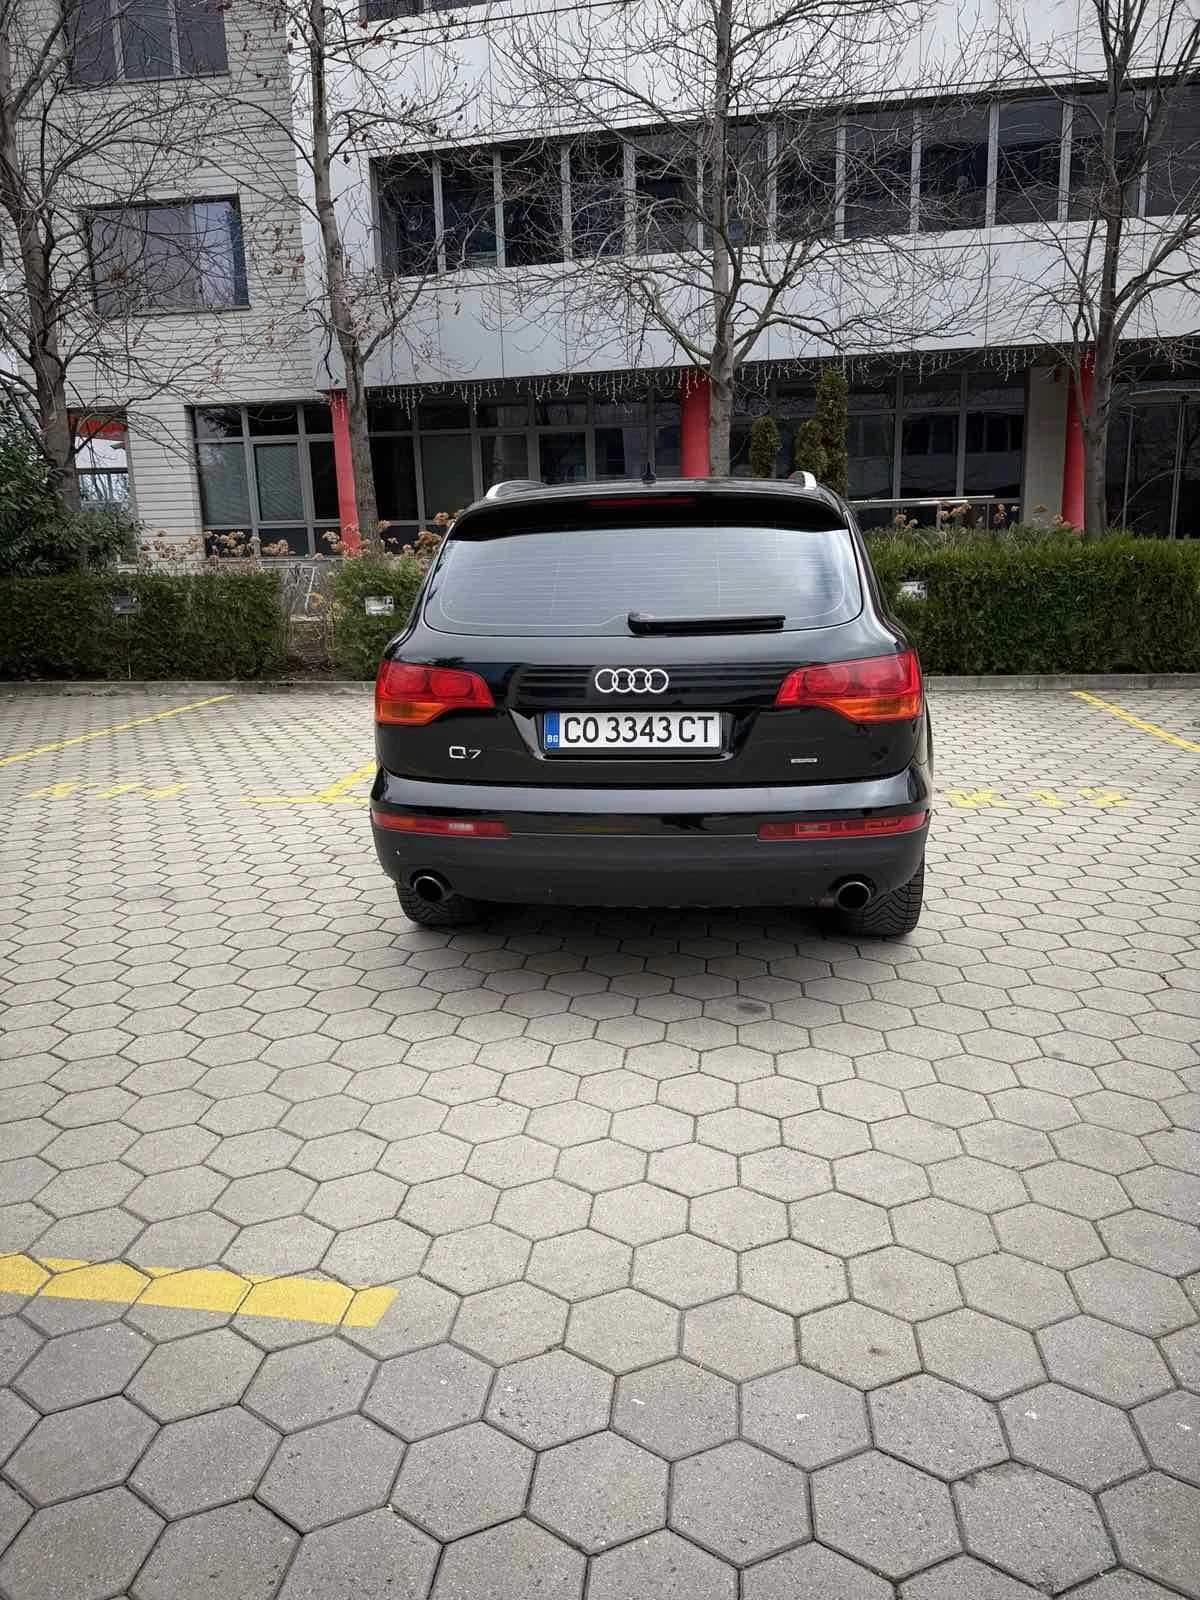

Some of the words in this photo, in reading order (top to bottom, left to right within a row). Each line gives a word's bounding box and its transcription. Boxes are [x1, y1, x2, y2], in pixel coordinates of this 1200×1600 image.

[564, 716, 599, 743] CO
[605, 716, 672, 743] 3343
[678, 716, 715, 743] CT
[546, 735, 559, 743] BG
[449, 746, 481, 759] Q7
